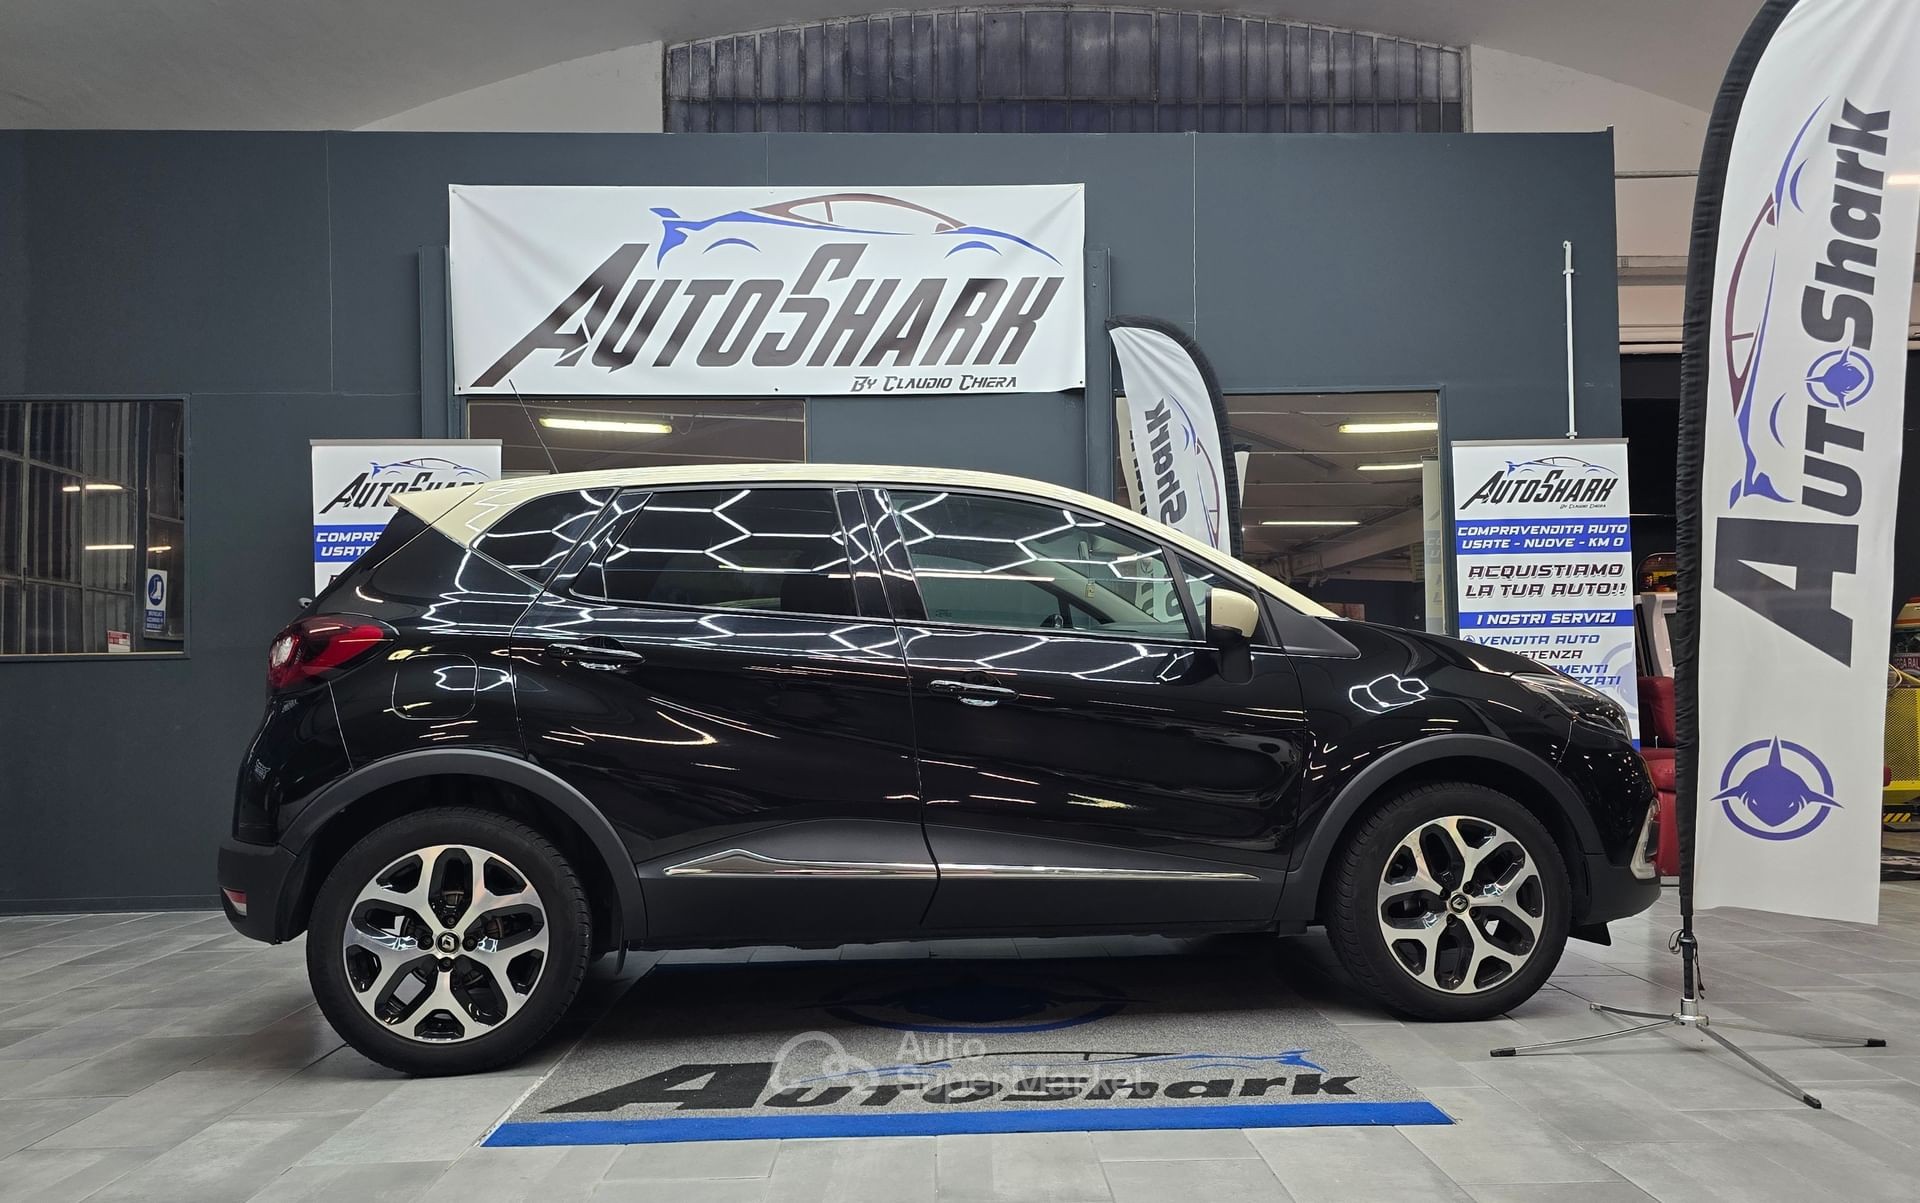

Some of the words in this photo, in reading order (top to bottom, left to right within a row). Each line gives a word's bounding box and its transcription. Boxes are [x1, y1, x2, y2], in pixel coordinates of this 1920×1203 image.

[883, 376, 953, 392] CLAUDIO
[959, 374, 1017, 391] CHIERA
[1457, 525, 1584, 536] COMPRAVENDITA
[1587, 524, 1628, 534] AUTO
[1462, 539, 1511, 549] USATE
[1523, 538, 1575, 548] NUOVE
[1588, 537, 1610, 547] KM
[1468, 563, 1624, 580] ACQUISTIAMO
[1465, 584, 1494, 597] LA
[1500, 583, 1545, 596] TUA
[1551, 583, 1627, 596] AUTO!!
[1476, 614, 1483, 625] I
[1486, 613, 1546, 625] NOSTRI
[1550, 612, 1617, 624] SERVIZI
[1478, 635, 1550, 645] VENDITA
[1555, 634, 1600, 644] AUTO
